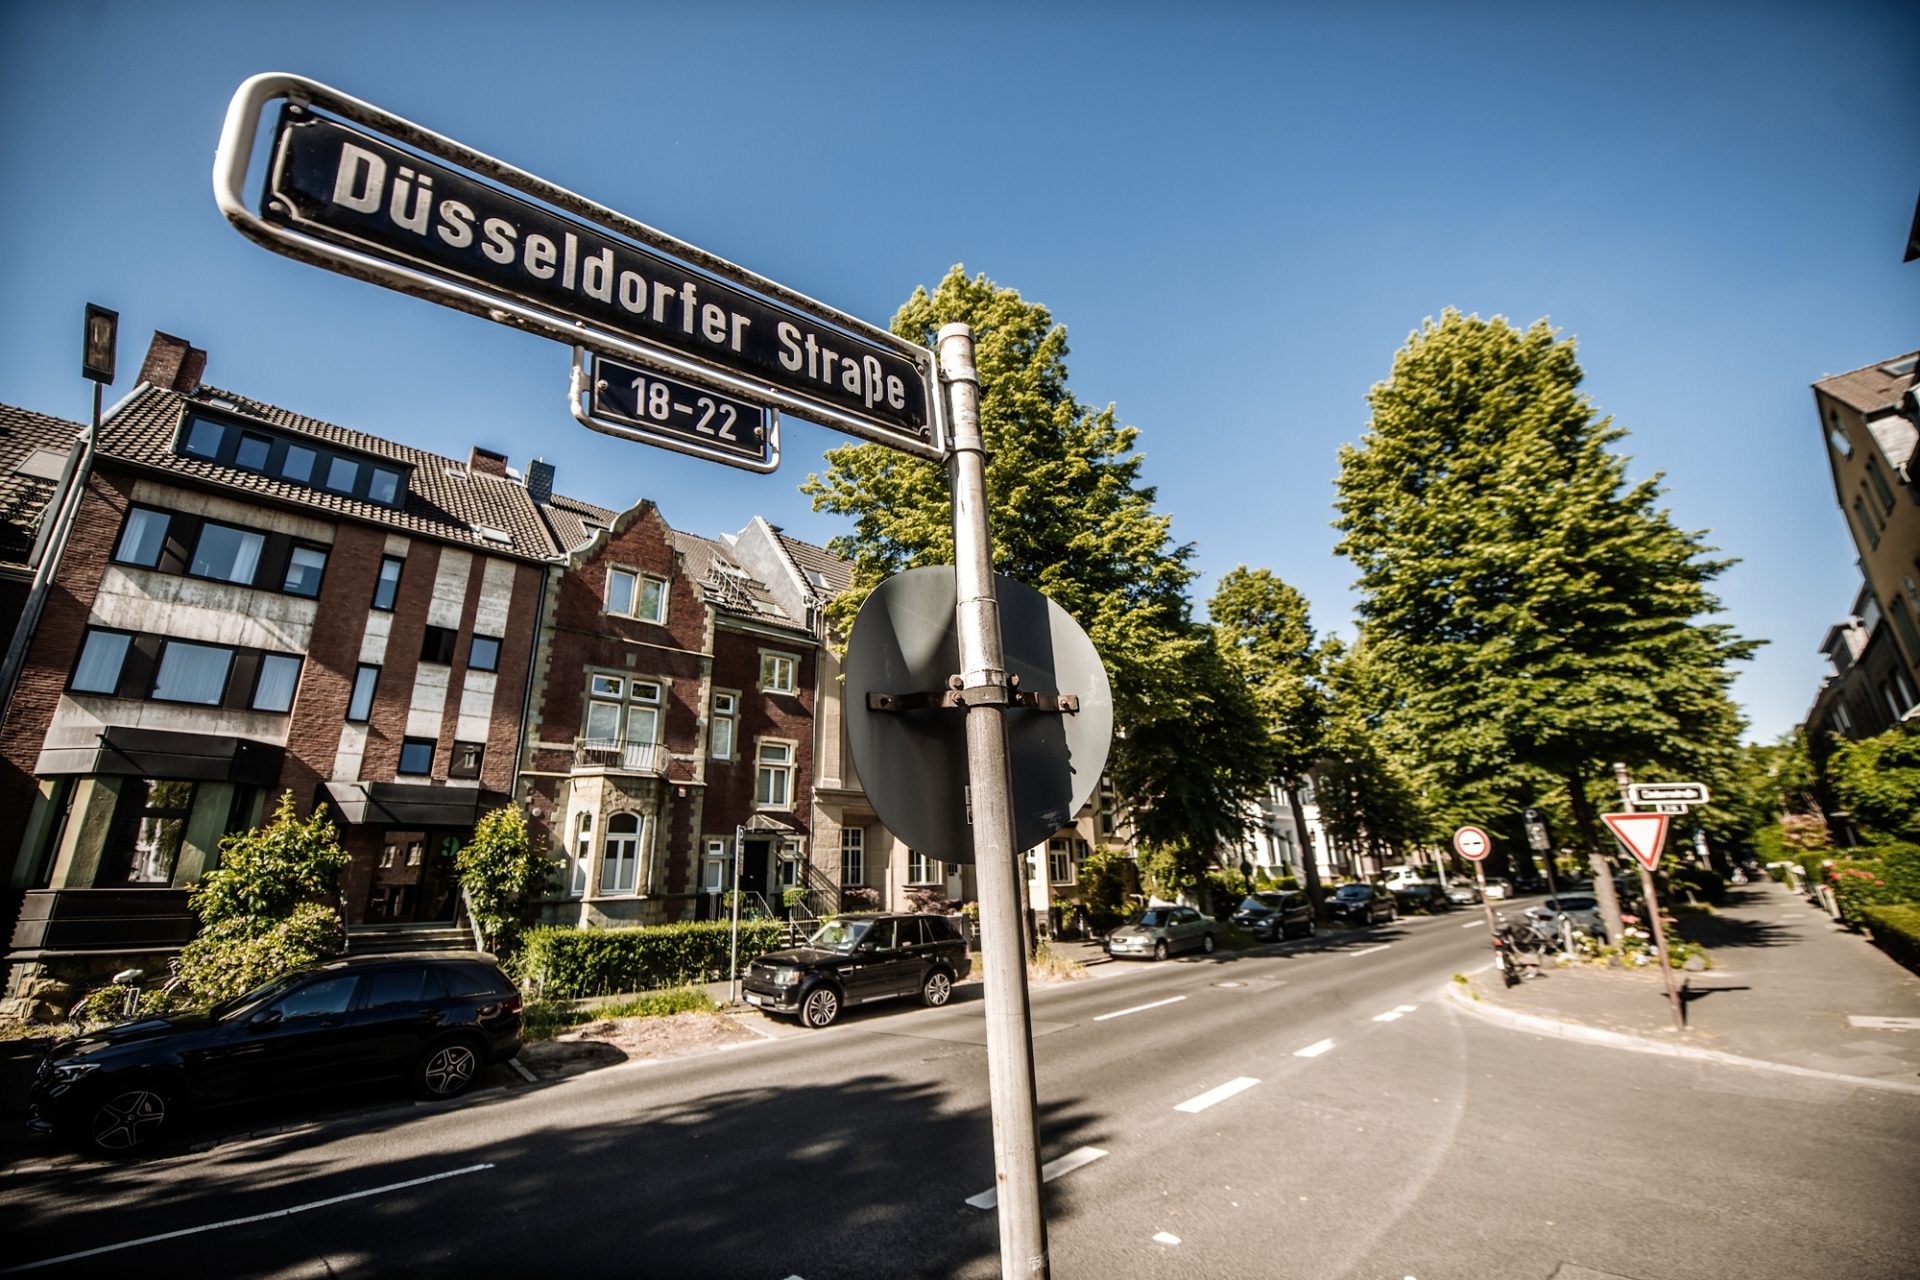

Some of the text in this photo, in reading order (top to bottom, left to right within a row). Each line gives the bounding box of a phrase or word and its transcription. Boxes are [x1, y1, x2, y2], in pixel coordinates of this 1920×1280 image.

[332, 142, 905, 410] Düsseldorfer Straße
[631, 377, 737, 441] 18-22
